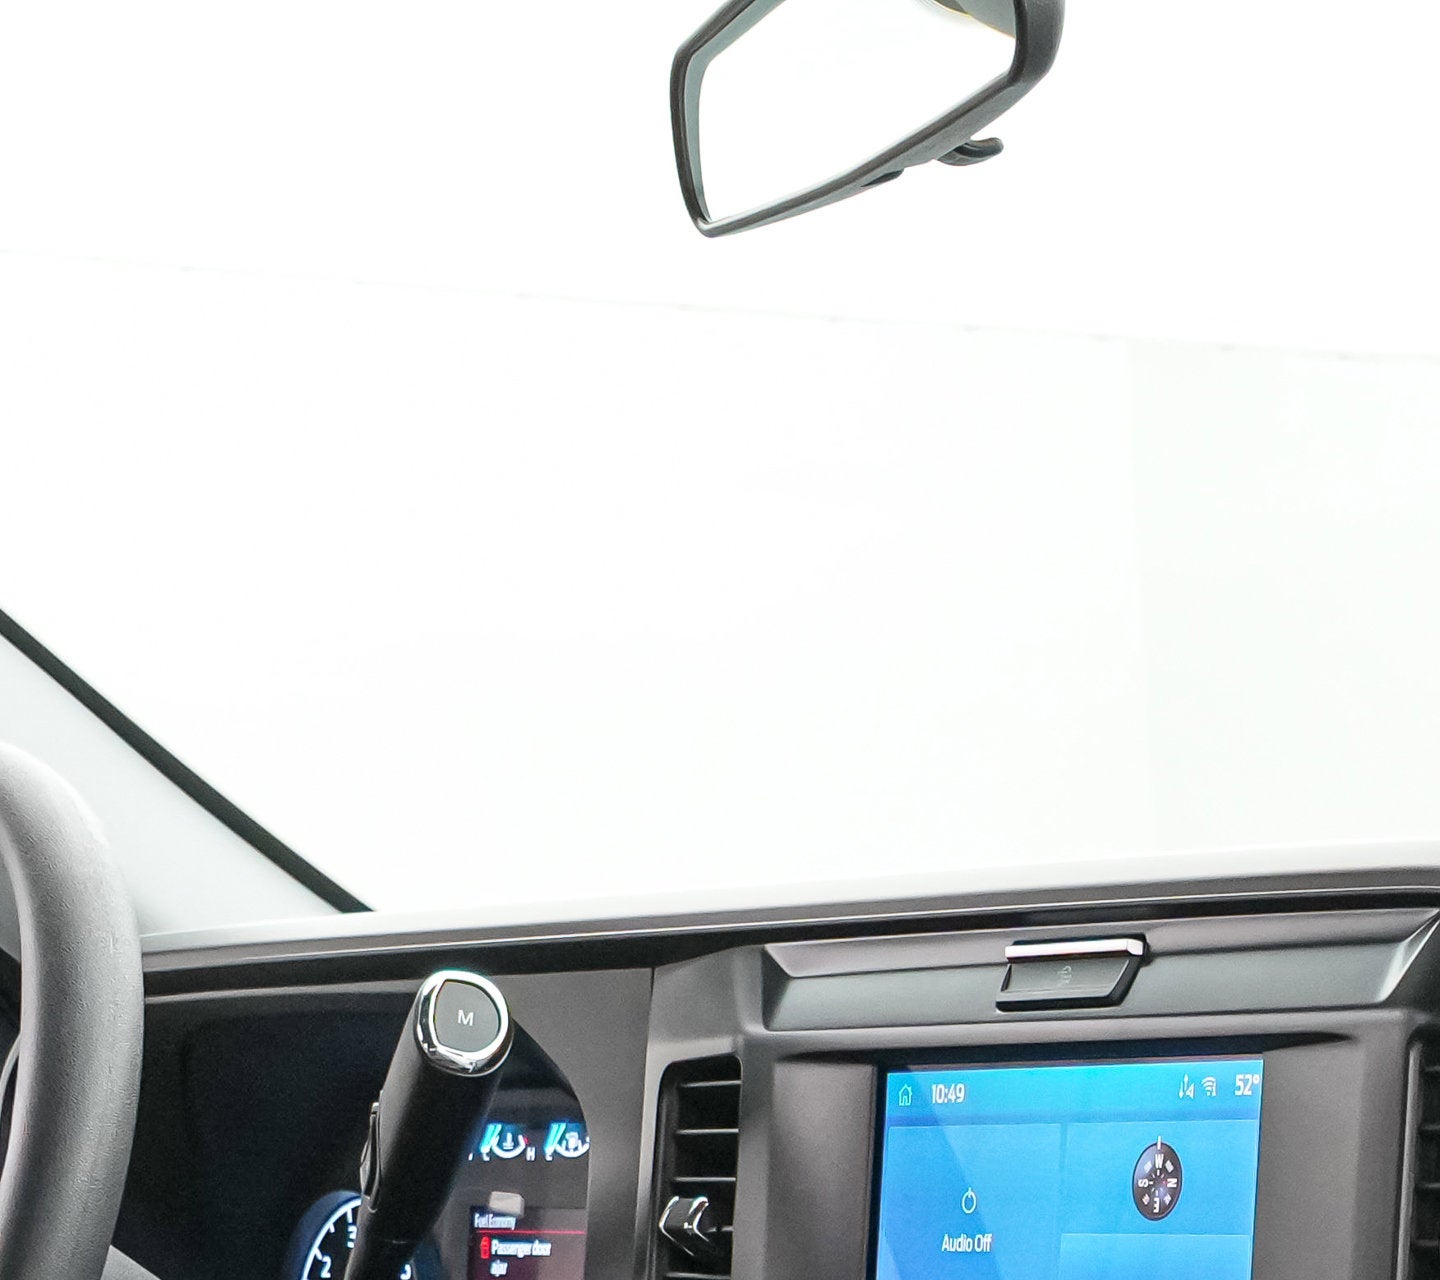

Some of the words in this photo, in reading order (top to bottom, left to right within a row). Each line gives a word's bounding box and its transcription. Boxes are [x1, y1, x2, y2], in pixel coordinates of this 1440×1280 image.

[458, 1009, 474, 1026] M
[931, 1084, 965, 1104] 10:49
[1155, 1153, 1164, 1168] W
[1138, 1178, 1148, 1188] S
[1167, 1178, 1177, 1188] N
[1153, 1197, 1160, 1213] E
[941, 1233, 973, 1252] Audio
[974, 1234, 992, 1252] Off
[321, 1255, 332, 1279] 2
